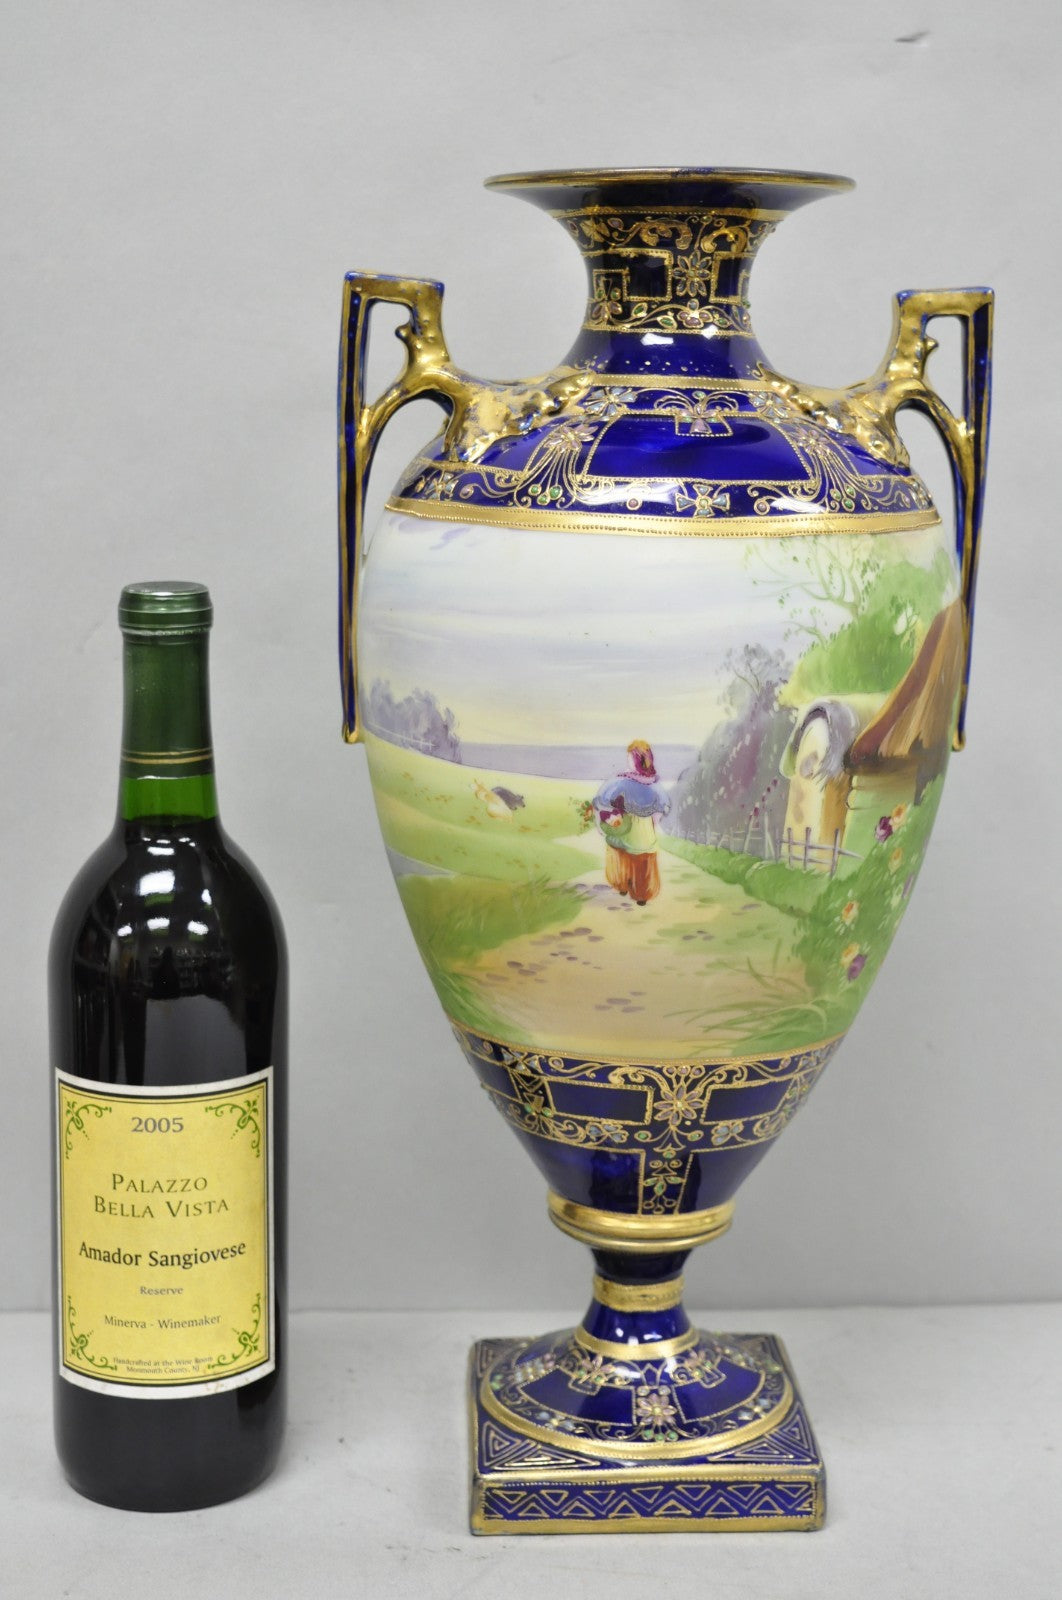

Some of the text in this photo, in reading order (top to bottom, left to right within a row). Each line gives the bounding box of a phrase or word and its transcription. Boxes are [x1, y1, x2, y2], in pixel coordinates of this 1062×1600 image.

[131, 1117, 184, 1133] 2005
[112, 1173, 208, 1193] PALAZZO
[94, 1195, 229, 1218] BELLA VISTA
[79, 1241, 246, 1270] Amador Sangiovese
[104, 1315, 147, 1329] Minerva
[157, 1314, 222, 1329] Winemaker
[113, 1357, 152, 1367] Handcrafted
